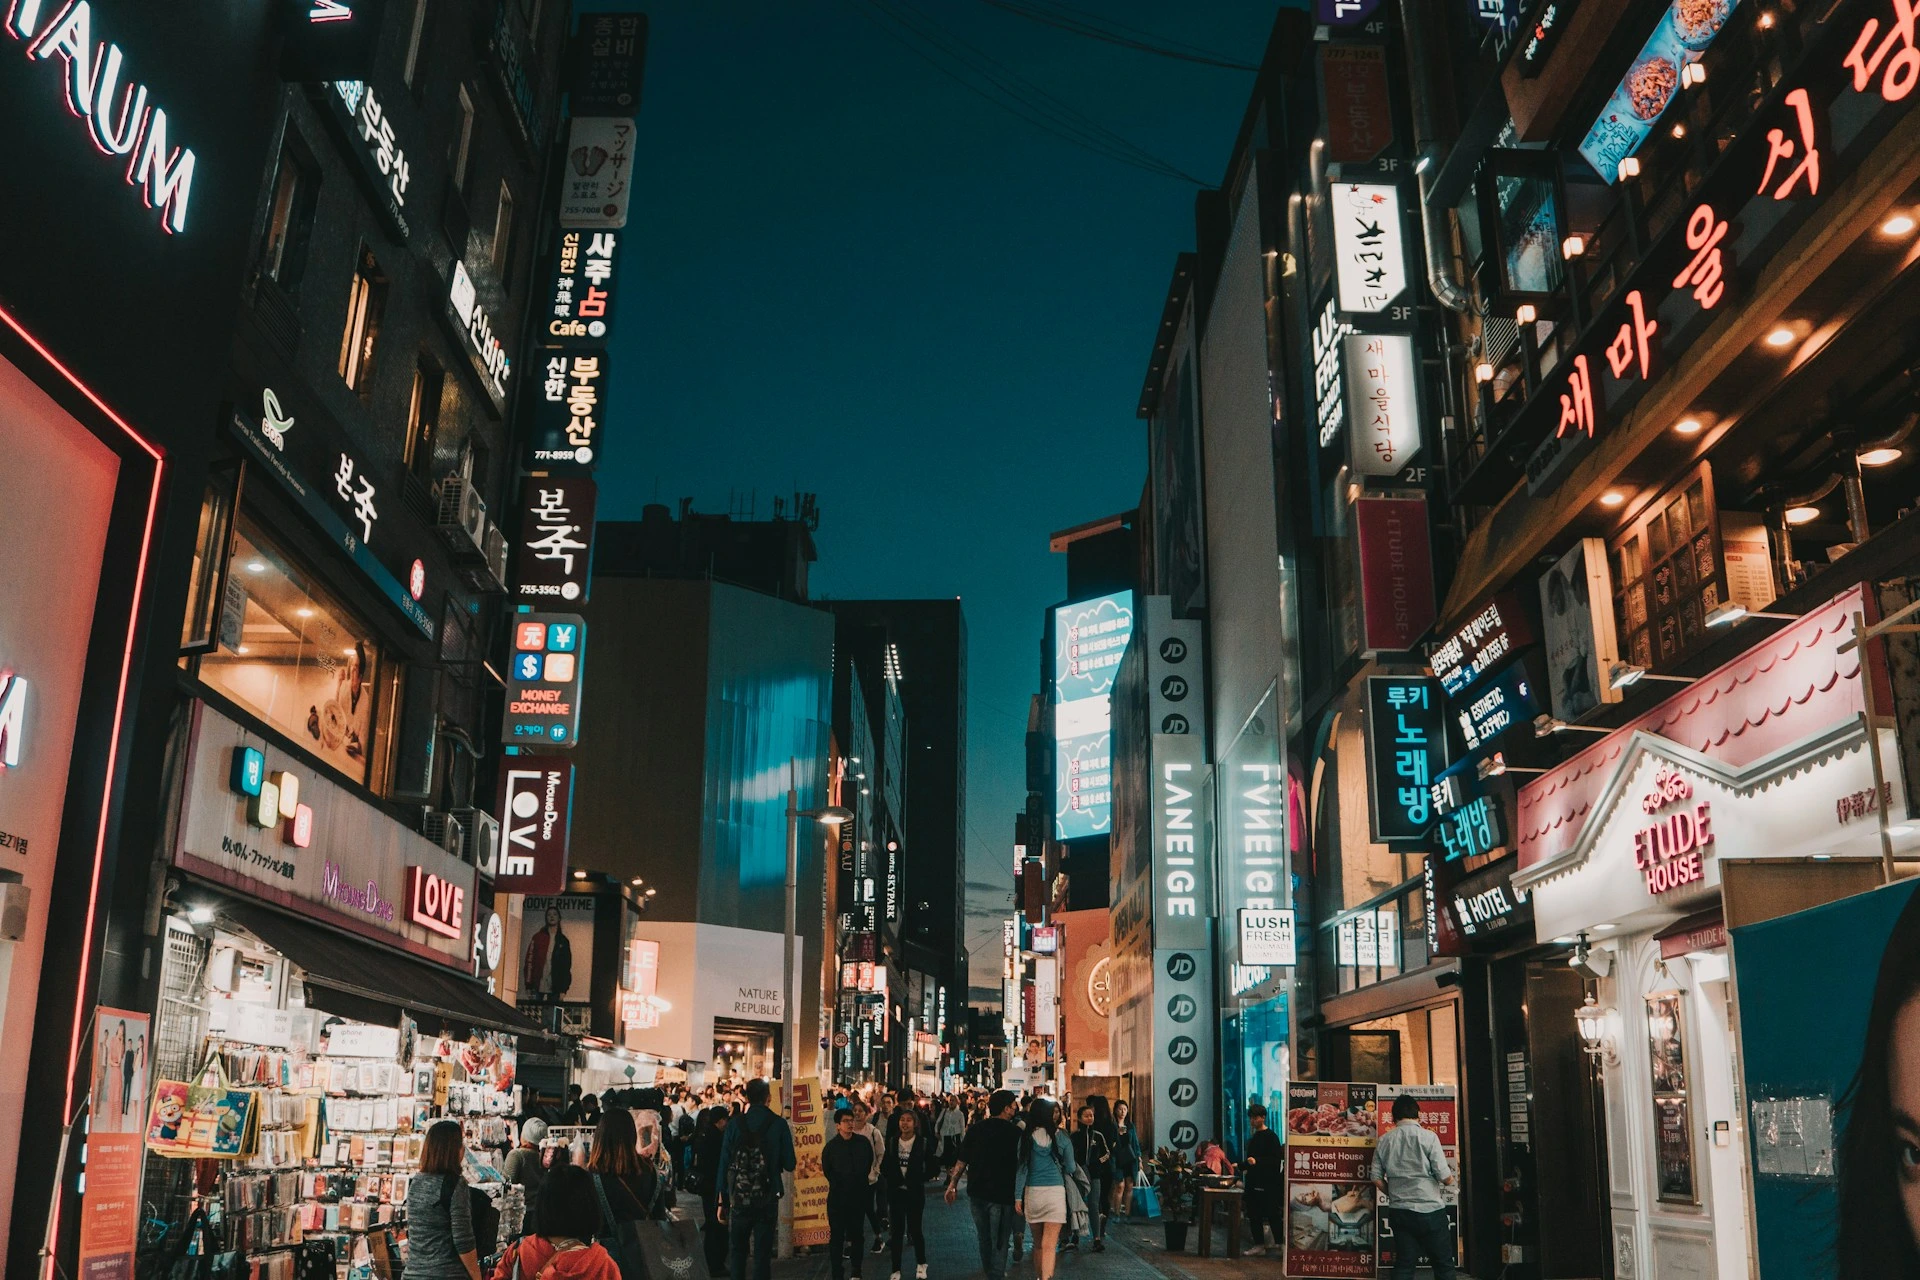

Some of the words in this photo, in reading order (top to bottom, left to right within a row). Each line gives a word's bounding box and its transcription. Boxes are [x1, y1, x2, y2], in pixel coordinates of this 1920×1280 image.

[1364, 22, 1384, 34] 4F
[6, 0, 195, 233] AUM
[607, 124, 630, 198] マッサージ
[1378, 159, 1398, 172] 3F
[560, 232, 580, 274] 신비안
[1391, 306, 1412, 320] 3F
[549, 320, 587, 337] Cafe
[544, 357, 568, 401] 신한
[565, 356, 600, 446] 부동산
[1364, 338, 1396, 463] 새마을식당
[1406, 468, 1426, 482] 2F
[526, 488, 588, 576] 본죽
[520, 584, 560, 596] 755-3562
[1392, 576, 1408, 631] HOUSE
[1164, 644, 1184, 658] JD
[521, 689, 562, 702] MONEY
[1164, 681, 1186, 696] JD
[1386, 687, 1429, 710] 루키
[1470, 686, 1504, 721] ESTHETIC
[510, 702, 570, 715] EXCHANGE
[1166, 720, 1187, 734] JD
[1394, 714, 1431, 824] 노래방
[1432, 777, 1455, 815] 루키
[500, 770, 542, 876] LOVE
[1440, 796, 1491, 862] 노래방
[1164, 764, 1196, 916] LANEIGE
[1633, 800, 1714, 872] ETUDE
[1645, 852, 1704, 895] HOUSE
[412, 866, 464, 940] LOVE
[886, 874, 896, 919] SKYPARK
[1467, 886, 1512, 923] HOTEL
[1246, 917, 1290, 928] LUSH
[1246, 931, 1290, 942] FRESH
[1690, 927, 1718, 949] ETUDE
[1170, 960, 1193, 974] JD
[738, 987, 778, 1001] NATURE
[734, 1002, 782, 1016] REPUBLIC
[1171, 1002, 1194, 1016] JD
[835, 1036, 846, 1044] 30
[1172, 1043, 1194, 1058] JD
[1172, 1086, 1194, 1100] JD
[1173, 1128, 1196, 1142] JD
[1312, 1151, 1336, 1160] Guest
[1338, 1152, 1364, 1161] House
[1312, 1162, 1337, 1170] Hotel
[1360, 1254, 1372, 1264] 8F
